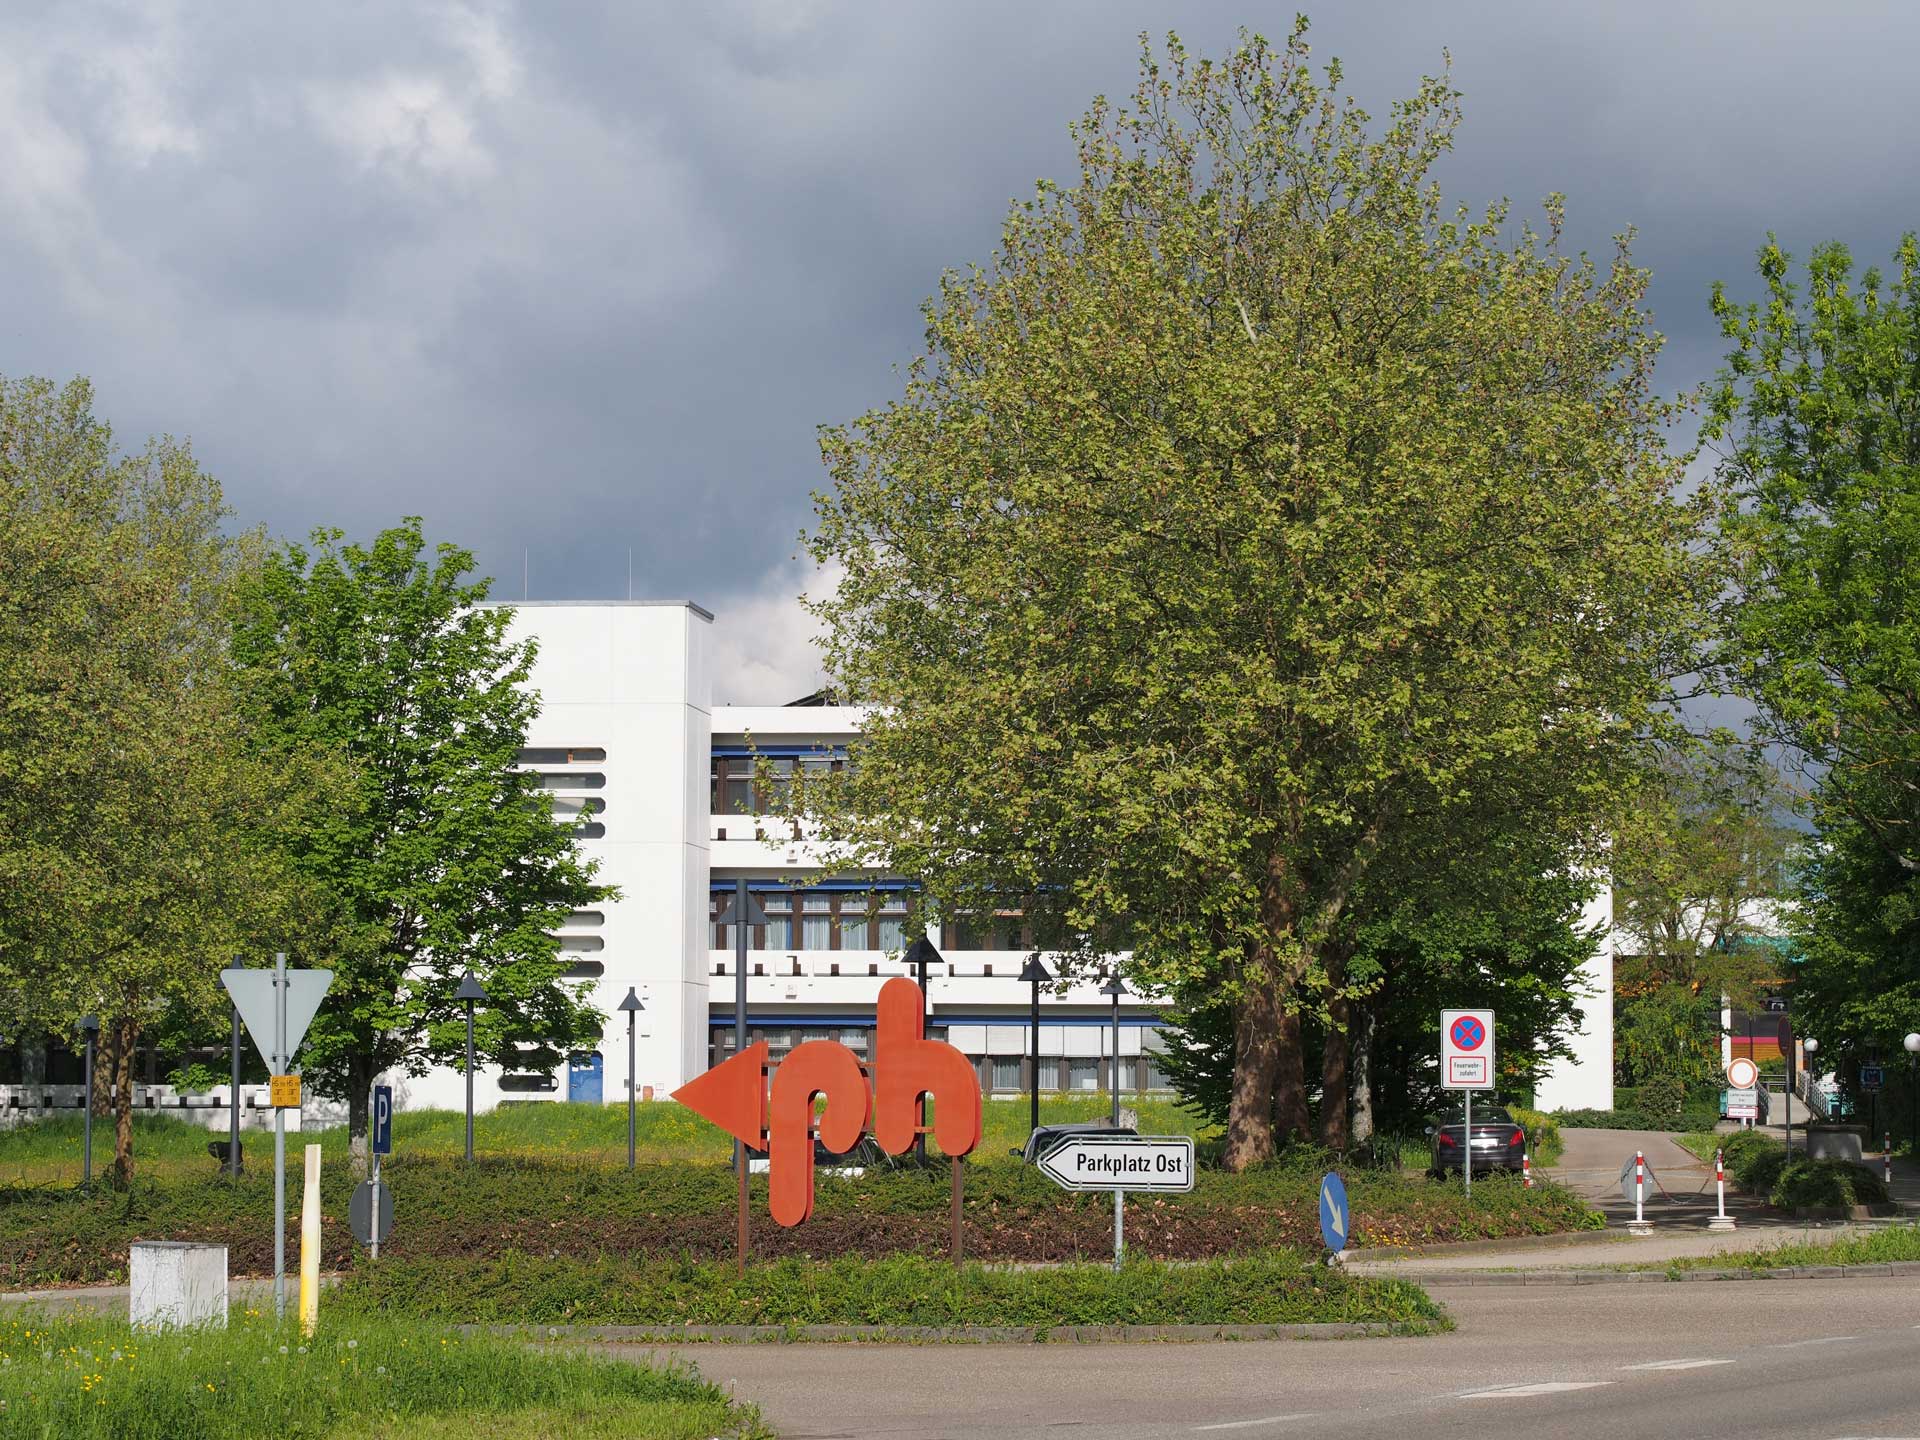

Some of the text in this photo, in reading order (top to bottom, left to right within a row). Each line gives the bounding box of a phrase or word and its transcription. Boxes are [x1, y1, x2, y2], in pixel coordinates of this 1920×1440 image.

[377, 1094, 388, 1143] P
[769, 977, 982, 1227] ph
[1077, 1153, 1182, 1176] Parkplatz Ost
